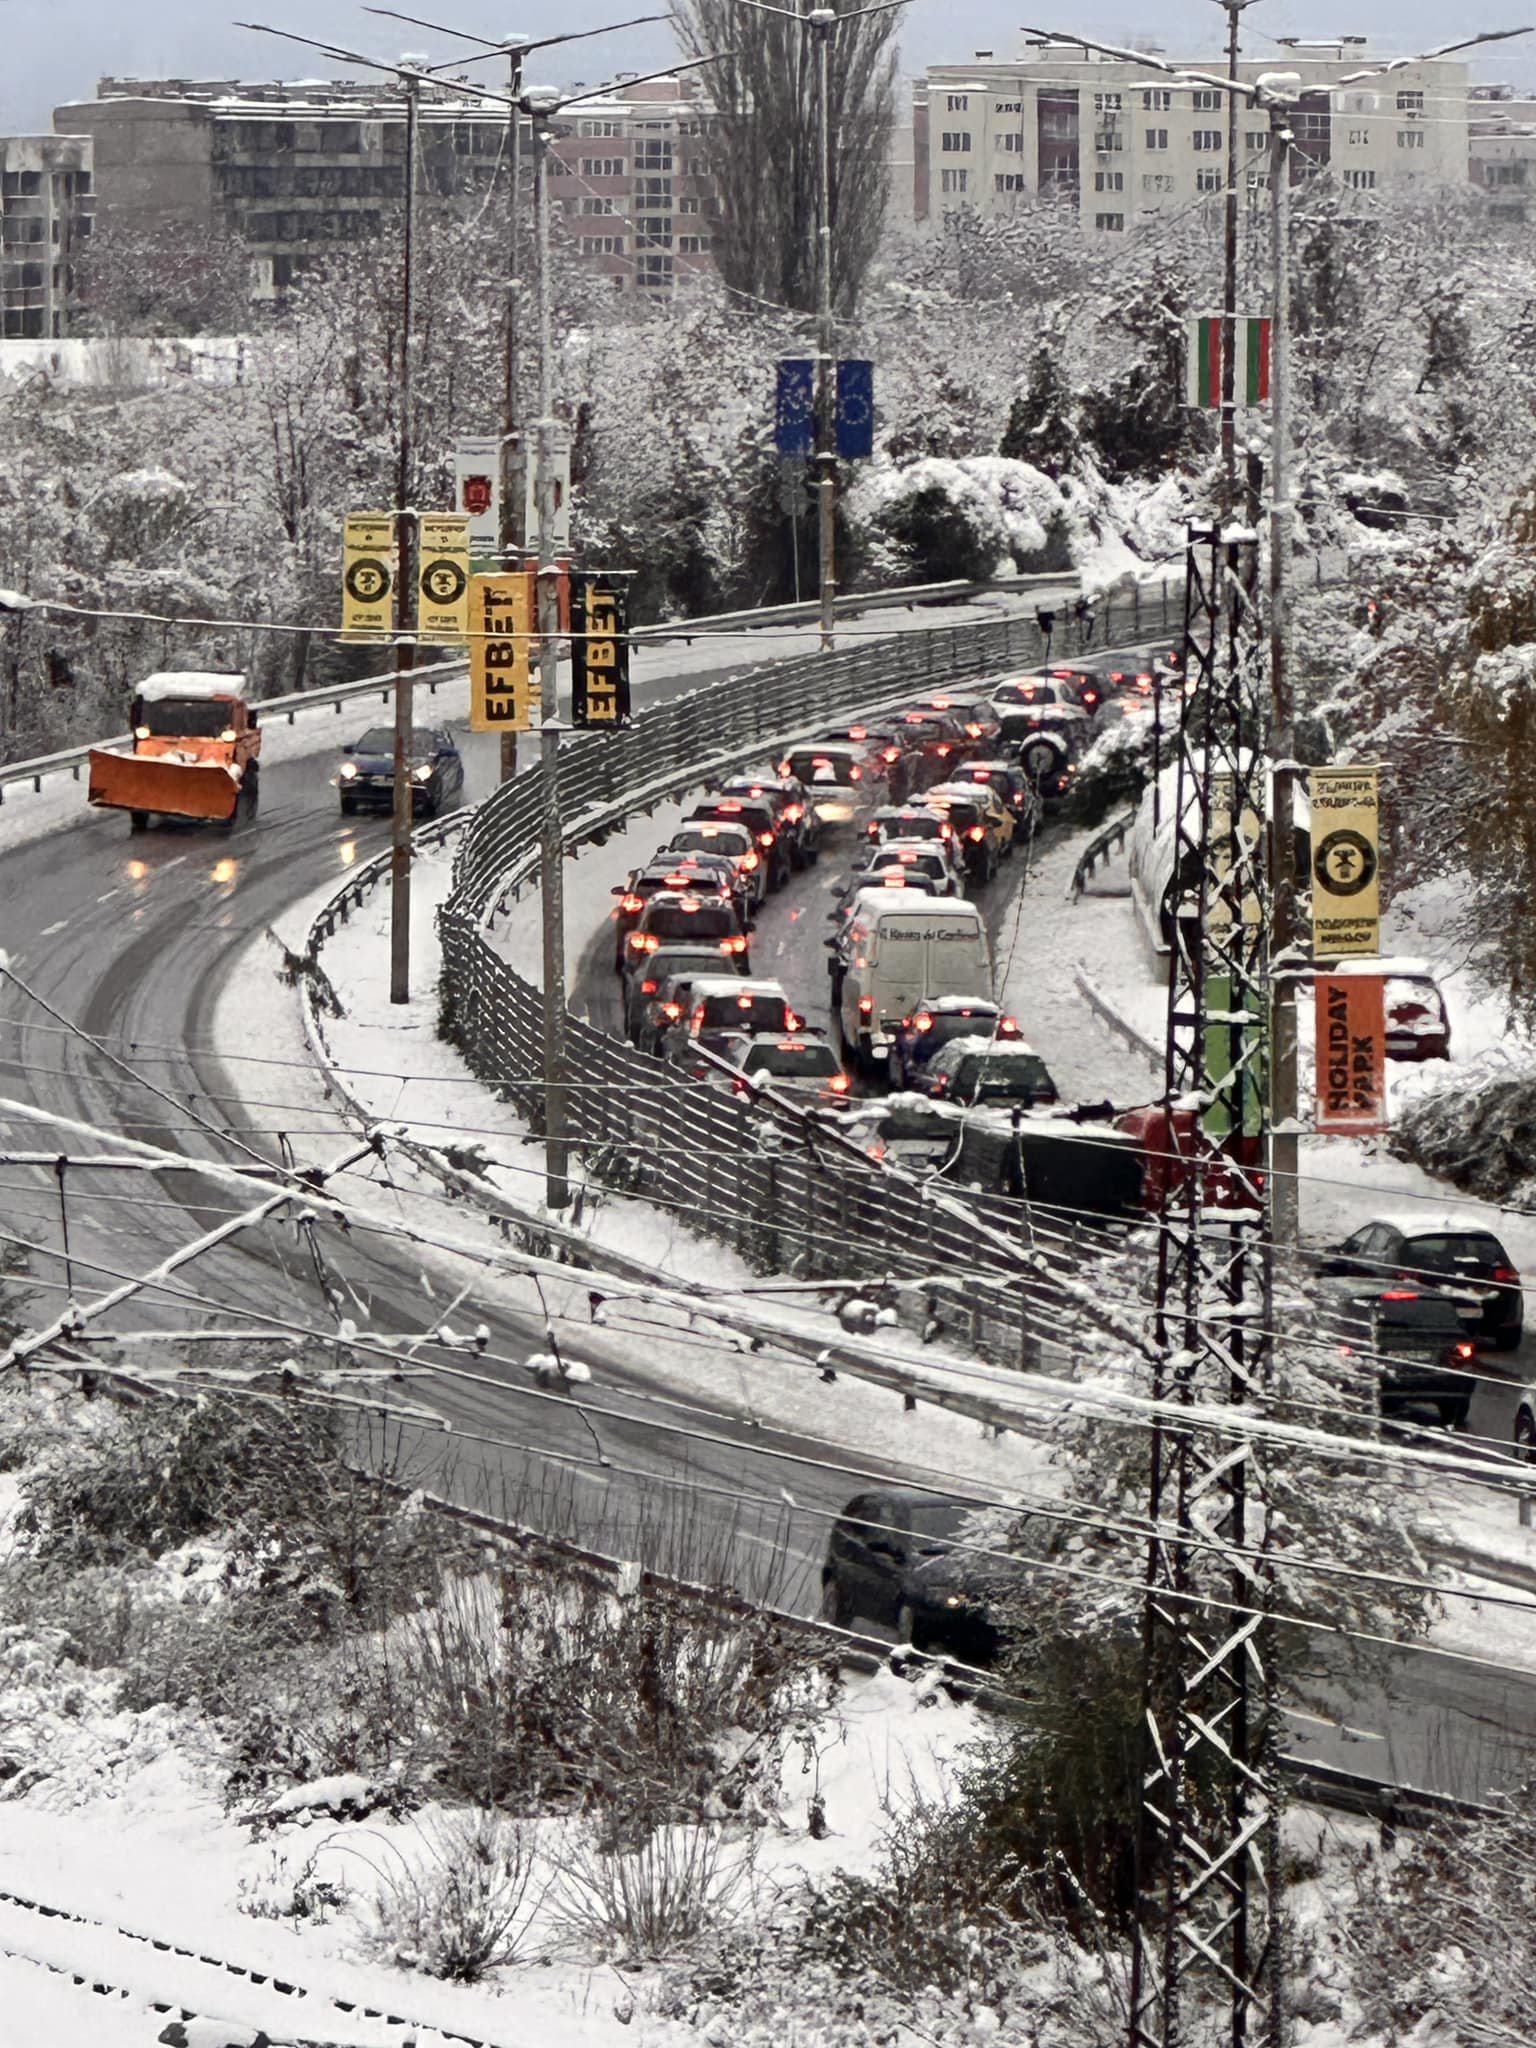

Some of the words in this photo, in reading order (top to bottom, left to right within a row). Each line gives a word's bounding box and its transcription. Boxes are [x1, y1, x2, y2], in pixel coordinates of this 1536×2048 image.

[484, 586, 514, 720] EFBET
[1328, 986, 1348, 1110] HOLIDAY
[1352, 1036, 1374, 1111] PARK
